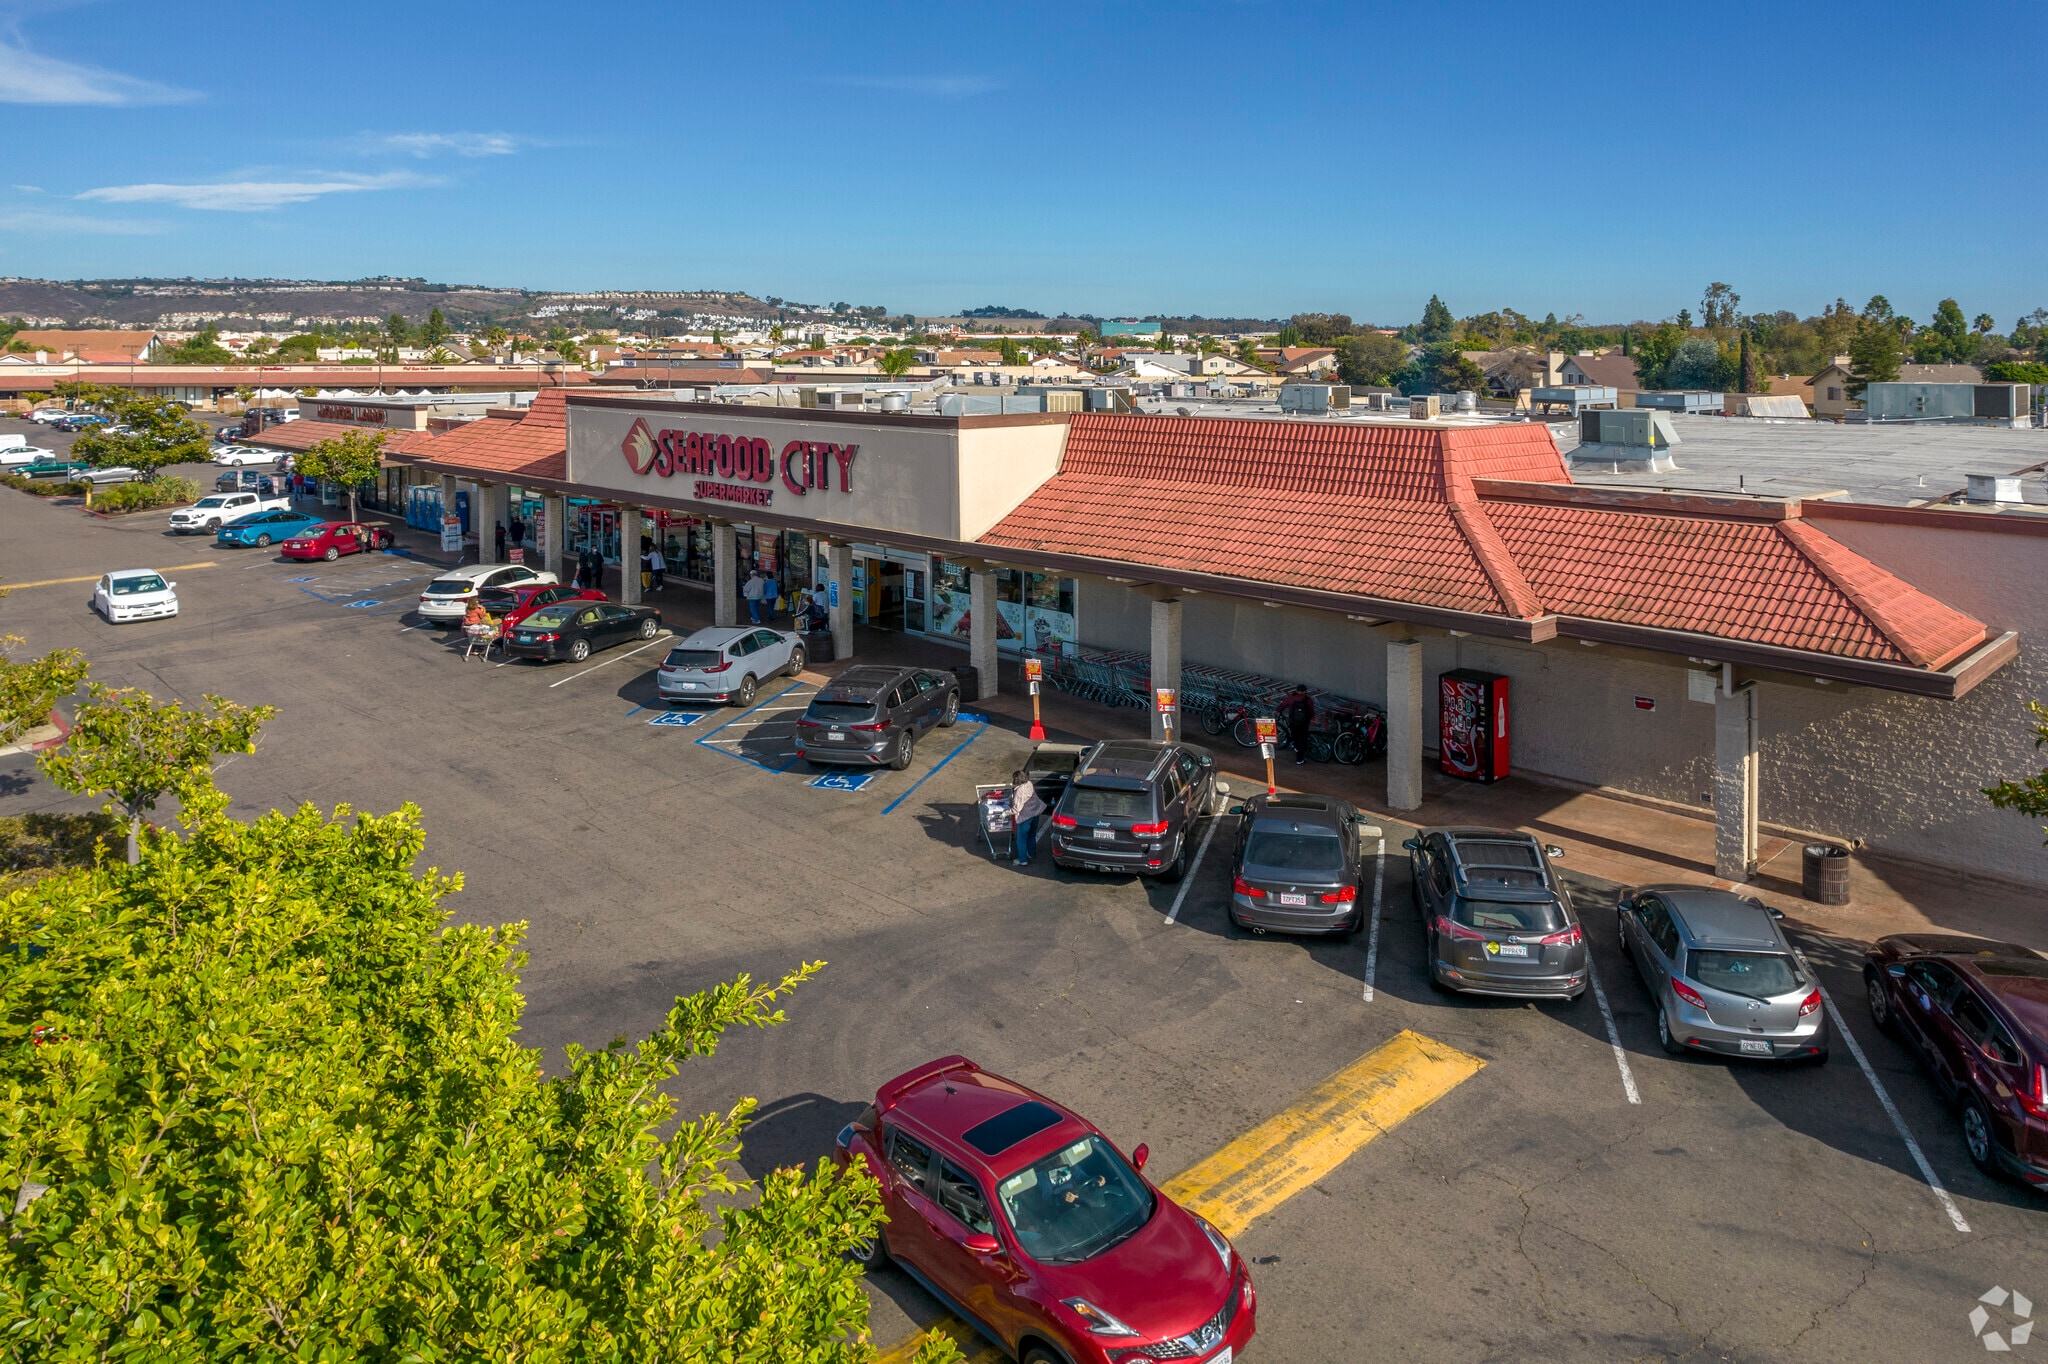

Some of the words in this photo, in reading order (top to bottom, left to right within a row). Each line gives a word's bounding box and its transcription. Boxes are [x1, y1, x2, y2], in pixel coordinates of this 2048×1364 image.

[356, 407, 386, 424] LAND
[654, 428, 775, 483] SEAFOOD
[780, 440, 859, 496] CITY
[693, 480, 773, 507] SUPERMARKET
